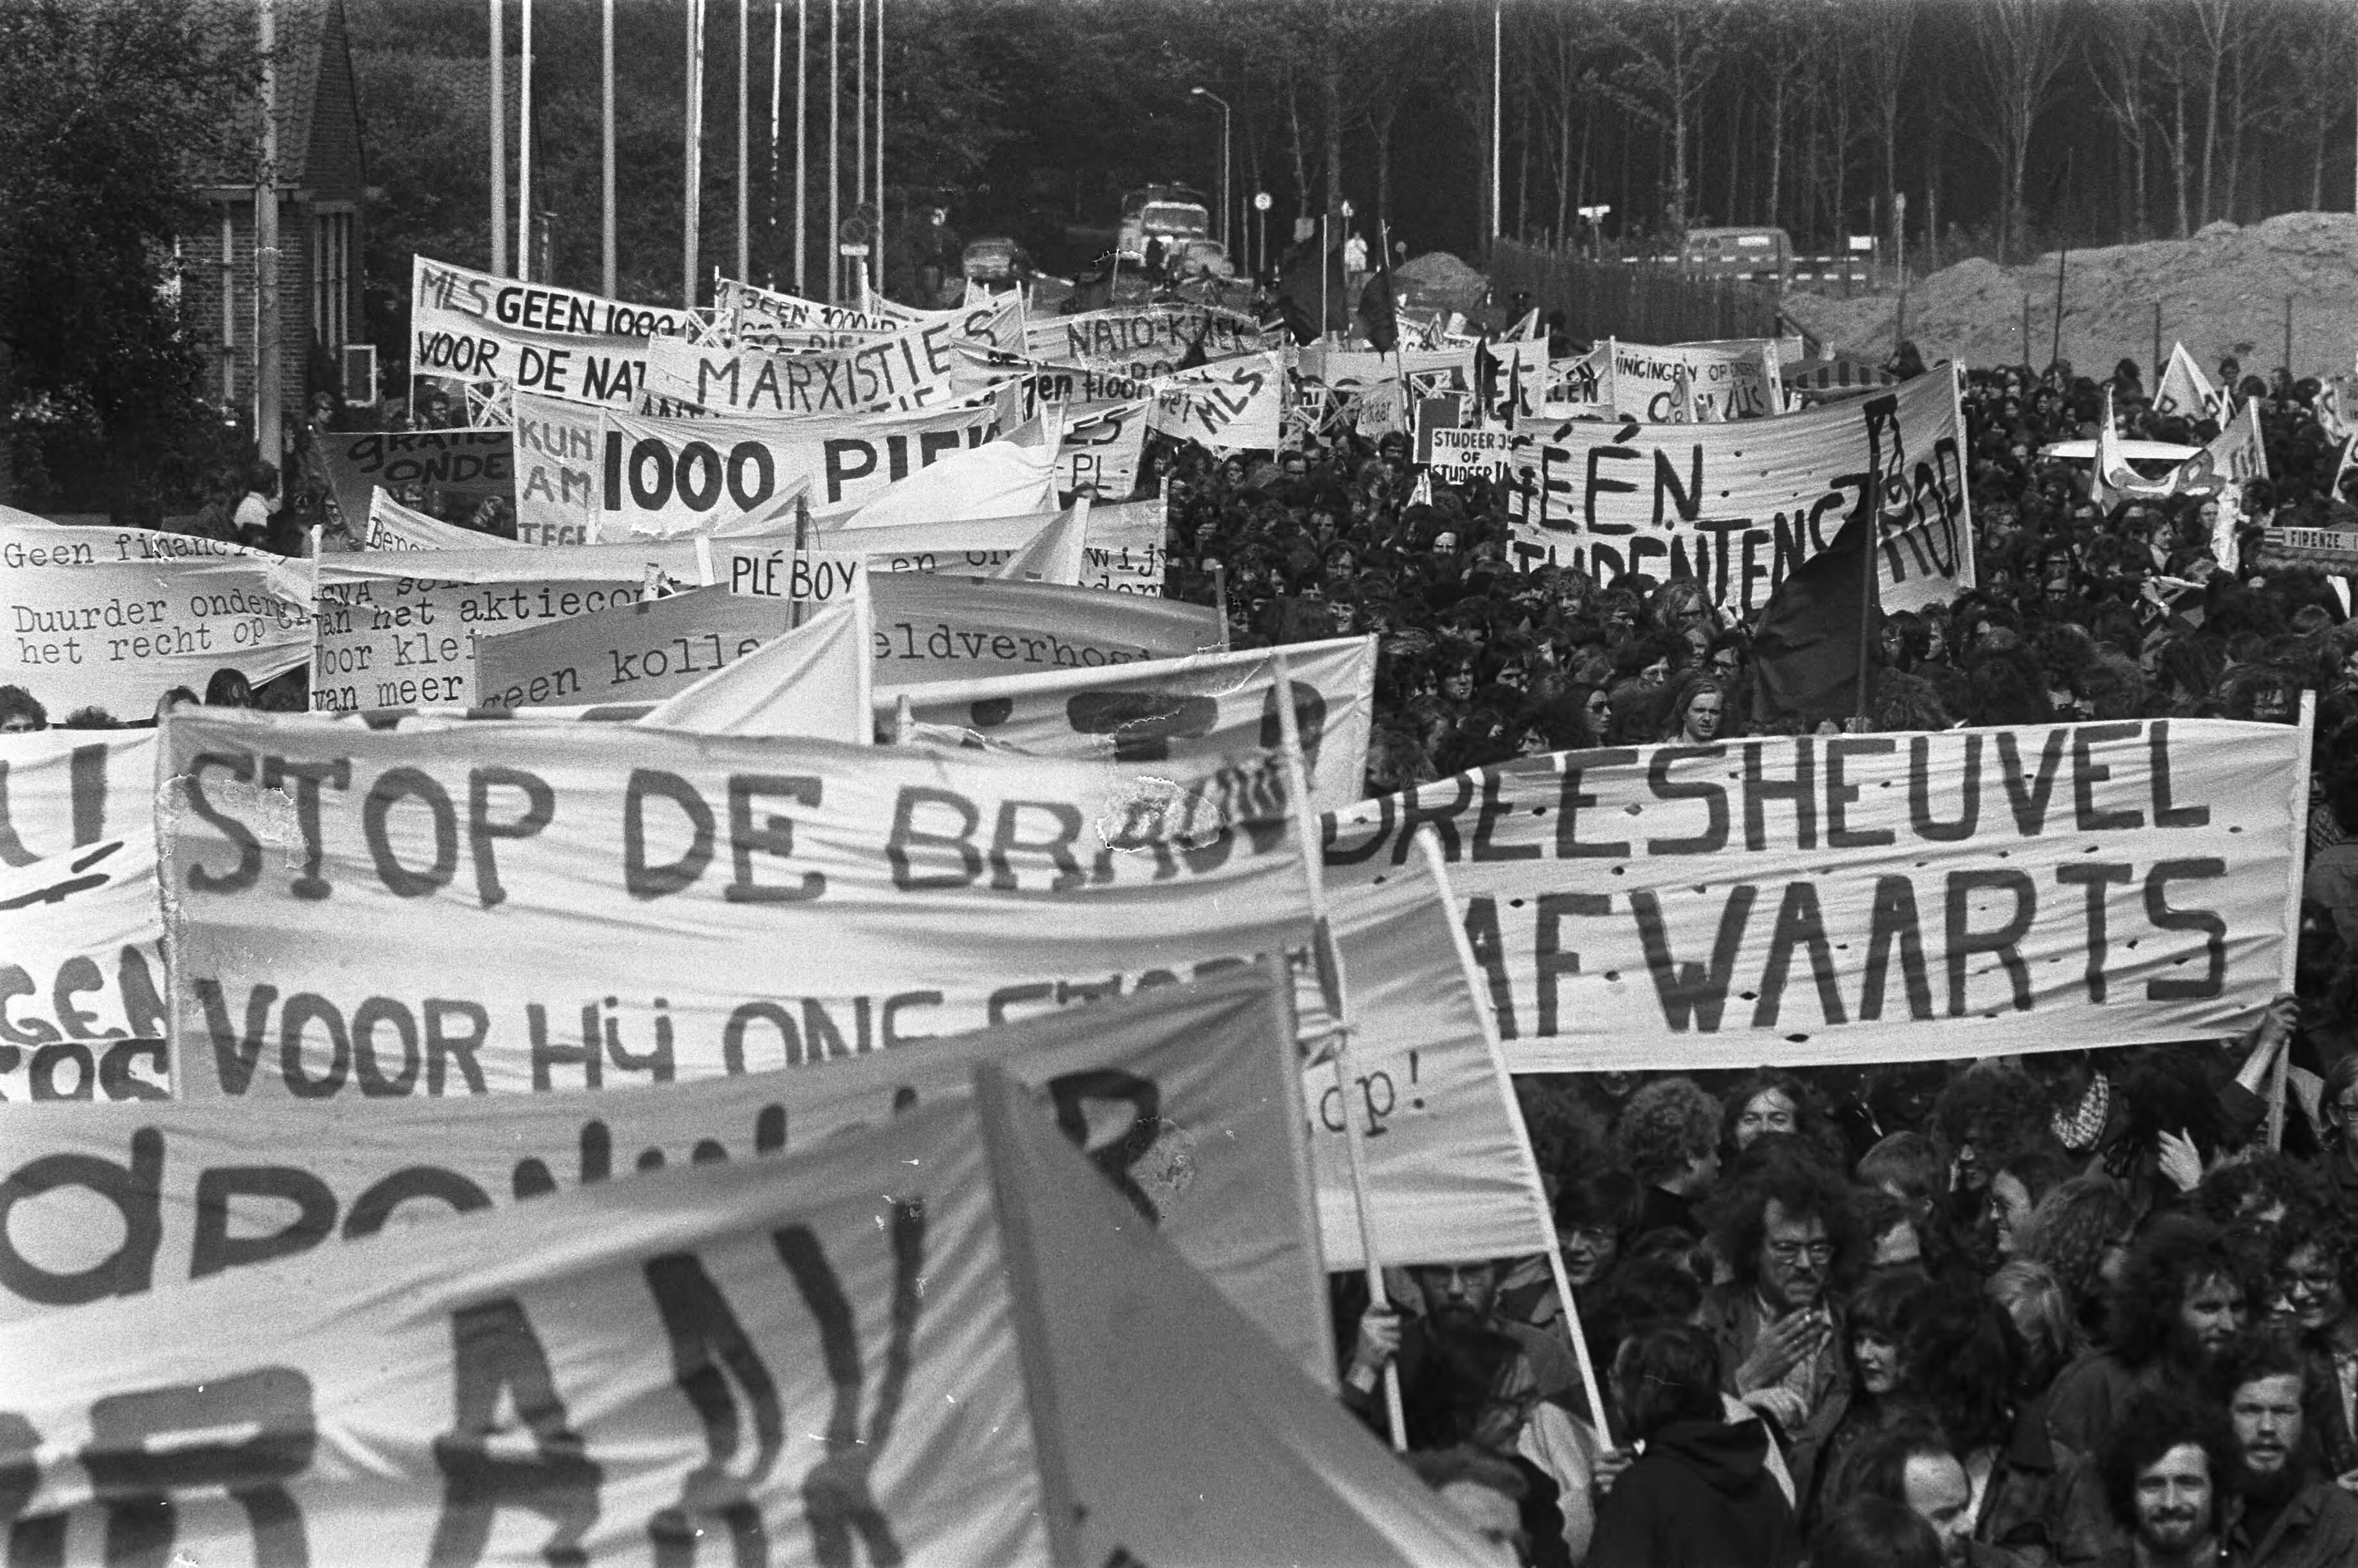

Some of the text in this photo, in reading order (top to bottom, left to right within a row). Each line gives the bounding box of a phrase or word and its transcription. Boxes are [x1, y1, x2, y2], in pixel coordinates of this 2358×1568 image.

[496, 286, 595, 334] GEEN
[418, 330, 500, 391] VOOR
[518, 348, 570, 406] DE
[1434, 430, 1495, 449] STUDEER
[1461, 451, 1481, 464] OF
[604, 430, 775, 513] 1000
[4, 542, 94, 568] Geen
[12, 598, 168, 633] Duurder
[371, 595, 434, 631] het
[21, 616, 265, 664] het recht op
[376, 675, 463, 707] meer
[1320, 720, 2210, 866] DREESHEUVEL
[186, 750, 555, 908] STOP
[624, 768, 826, 903] DE
[1464, 858, 2228, 1041] AFWAARTS
[195, 978, 490, 1097] VOOR
